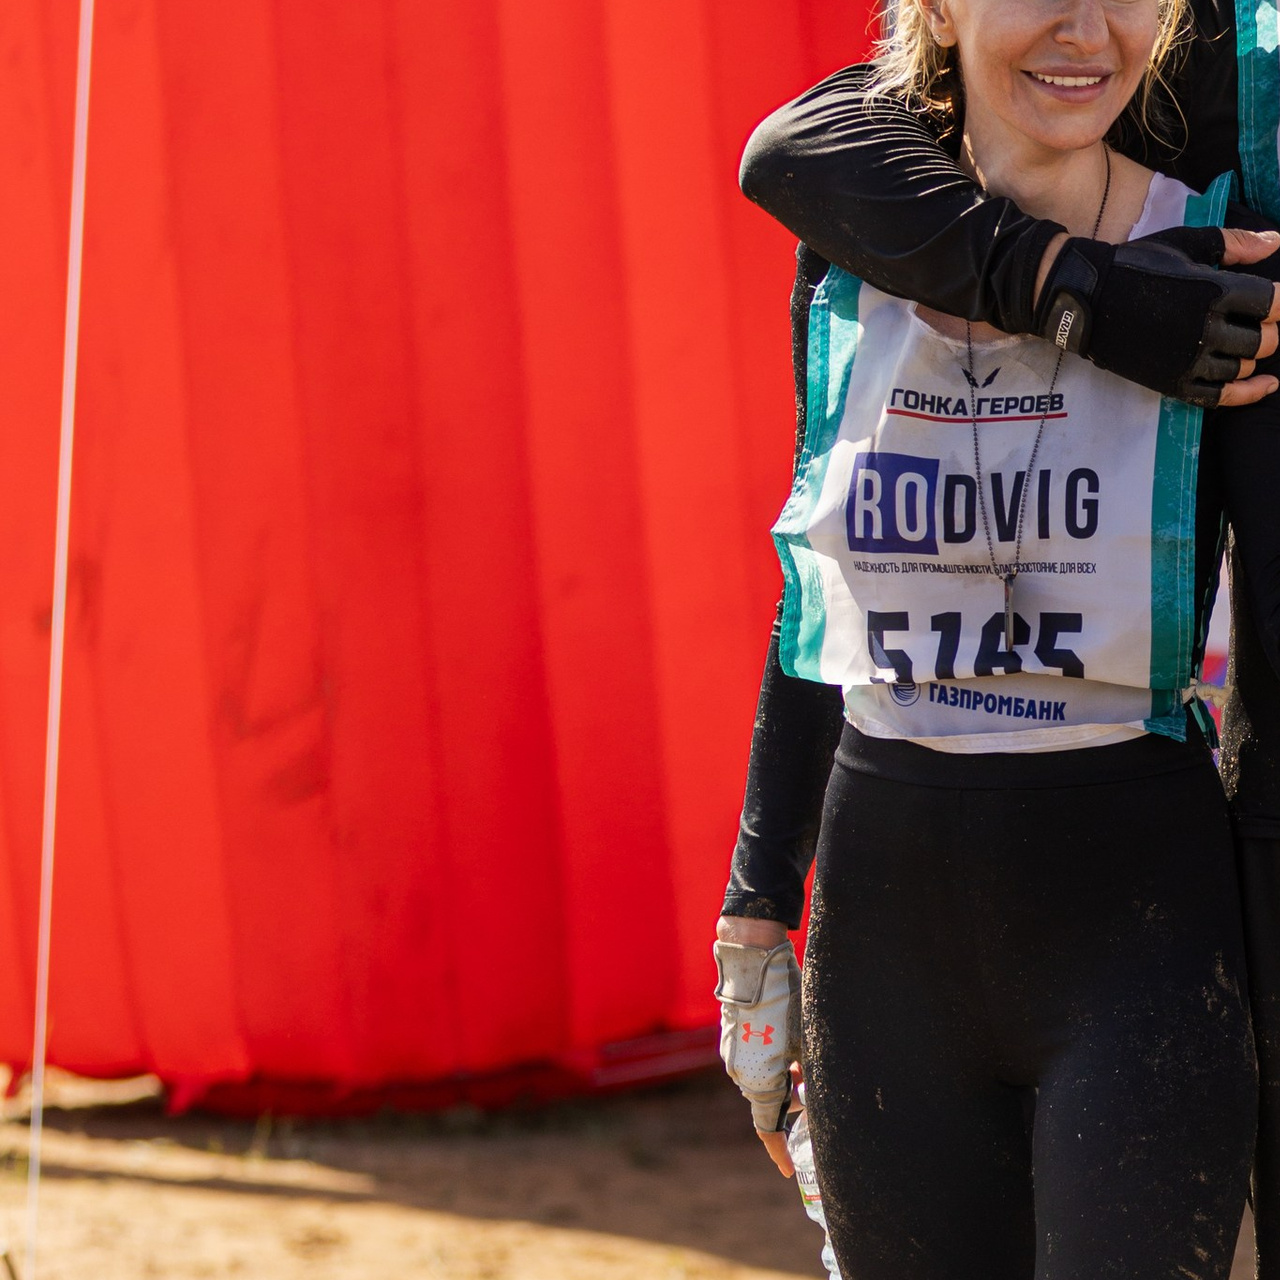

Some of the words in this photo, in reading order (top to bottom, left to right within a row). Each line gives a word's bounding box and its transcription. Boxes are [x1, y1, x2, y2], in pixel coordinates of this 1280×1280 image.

[890, 388, 967, 417] ГОНКА
[976, 393, 1065, 415] ГЕРОЕВ
[854, 467, 1101, 543] RODVIG
[854, 561, 899, 574] НАДЕЖНОСТЬ
[901, 562, 918, 574] ДЛЯ
[1059, 562, 1076, 574] ДЛЯ
[1077, 562, 1097, 574] ВСЕХ
[867, 610, 1085, 683] 5165
[929, 683, 1066, 721] ГАЗПРОМБАНК
